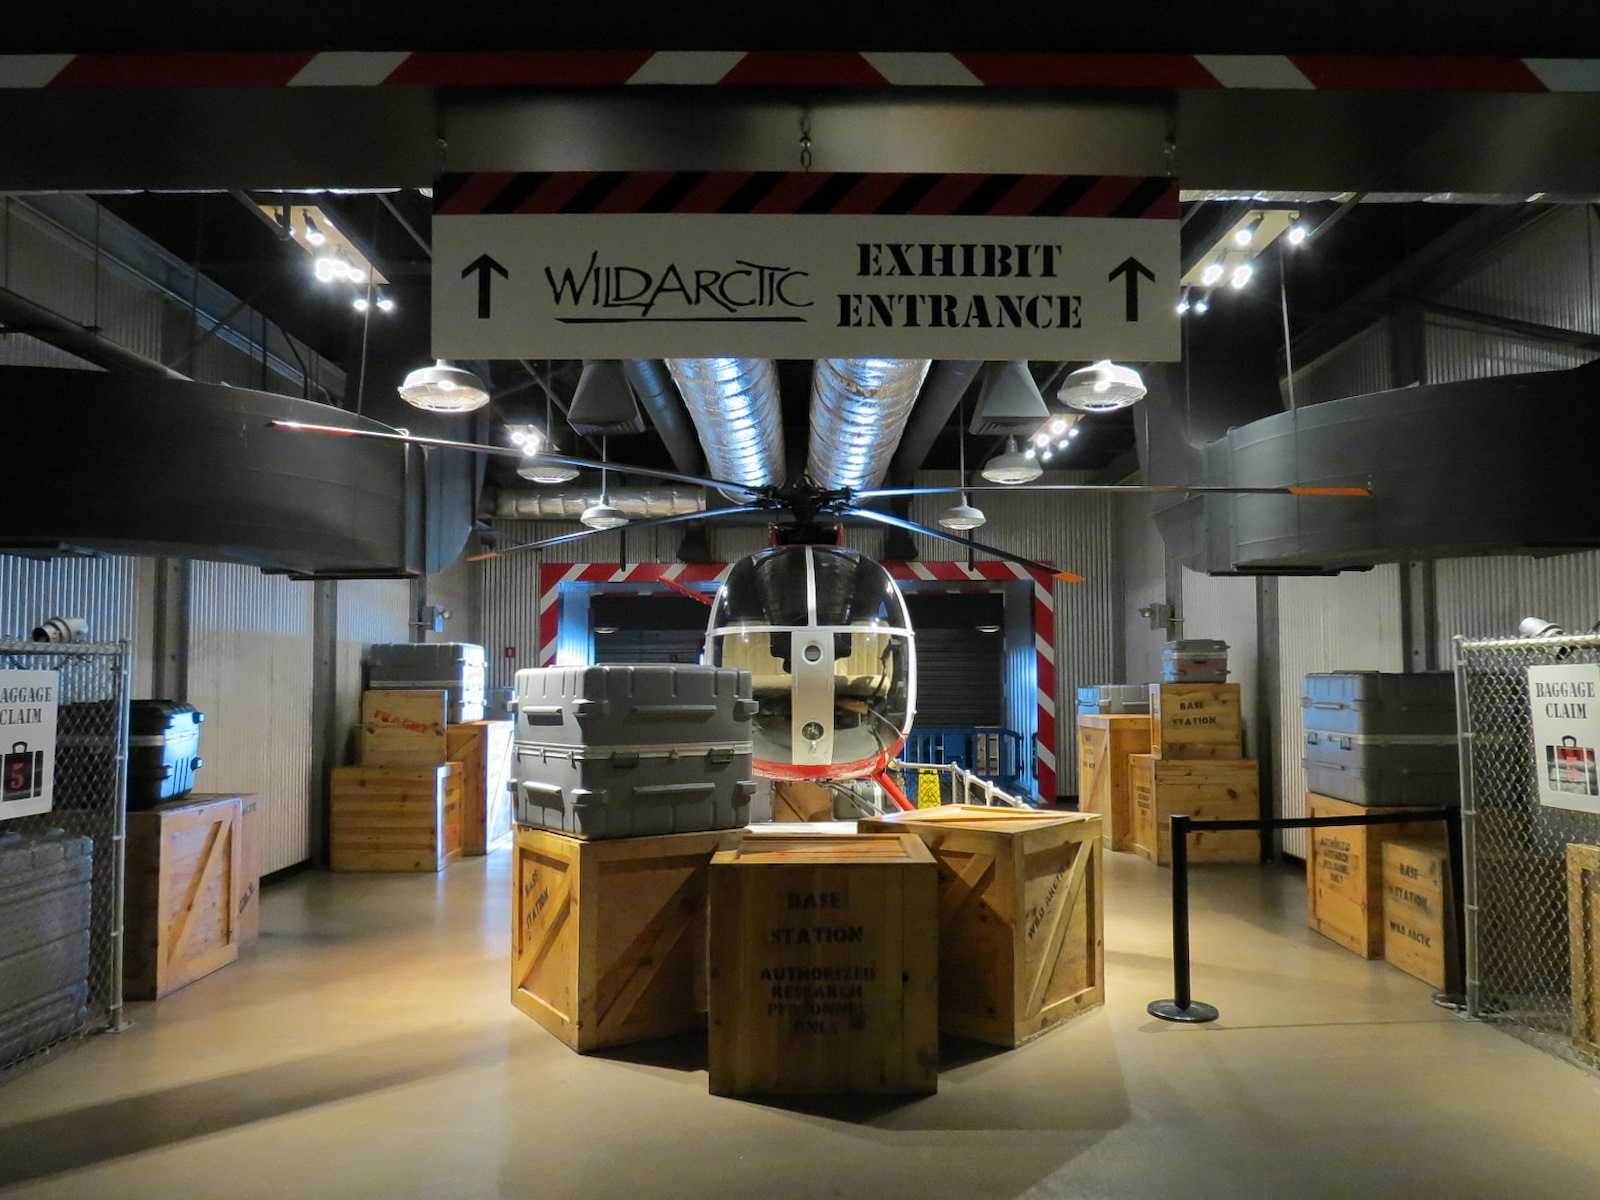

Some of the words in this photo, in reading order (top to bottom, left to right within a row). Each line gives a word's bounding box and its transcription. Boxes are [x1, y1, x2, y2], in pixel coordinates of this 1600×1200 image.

[856, 242, 1062, 277] EXHIBIT
[835, 294, 1082, 330] ENTRANCE
[0, 686, 52, 704] AGGAGE
[1535, 682, 1595, 698] BAGGAGE
[1179, 701, 1204, 711] BASE
[1545, 703, 1588, 719] CLAIM
[0, 708, 42, 725] CLAIM
[1172, 716, 1217, 726] STATION
[10, 762, 24, 789] 5
[1399, 863, 1419, 880] BASE
[785, 892, 841, 910] BASE
[1394, 886, 1428, 909] STATION
[771, 926, 864, 944] STATION
[760, 966, 876, 981] AUTHORIZED
[771, 984, 863, 999] RESEARCH
